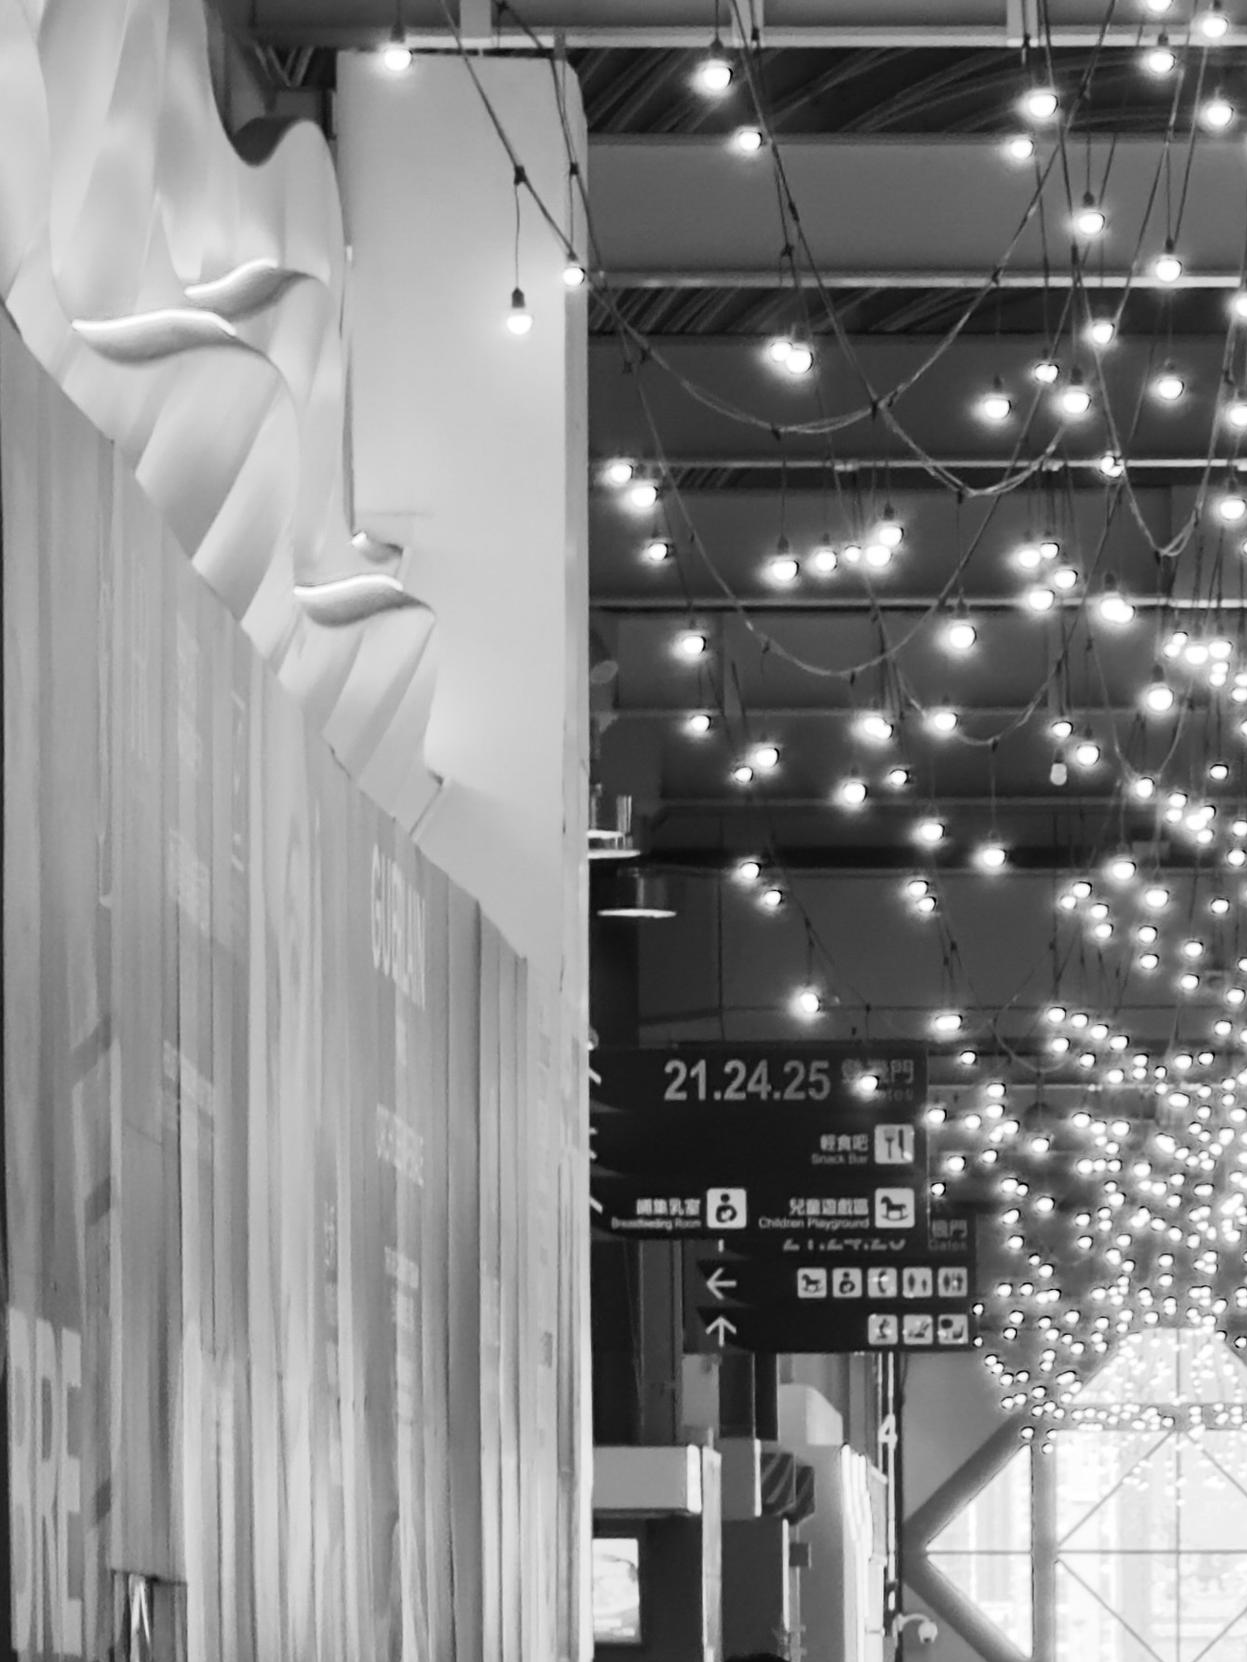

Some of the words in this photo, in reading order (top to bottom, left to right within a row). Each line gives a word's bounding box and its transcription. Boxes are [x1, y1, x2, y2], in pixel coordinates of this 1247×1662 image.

[663, 1058, 832, 1101] 21.24.25
[758, 1217, 804, 1230] Children
[807, 1217, 870, 1232] Playground
